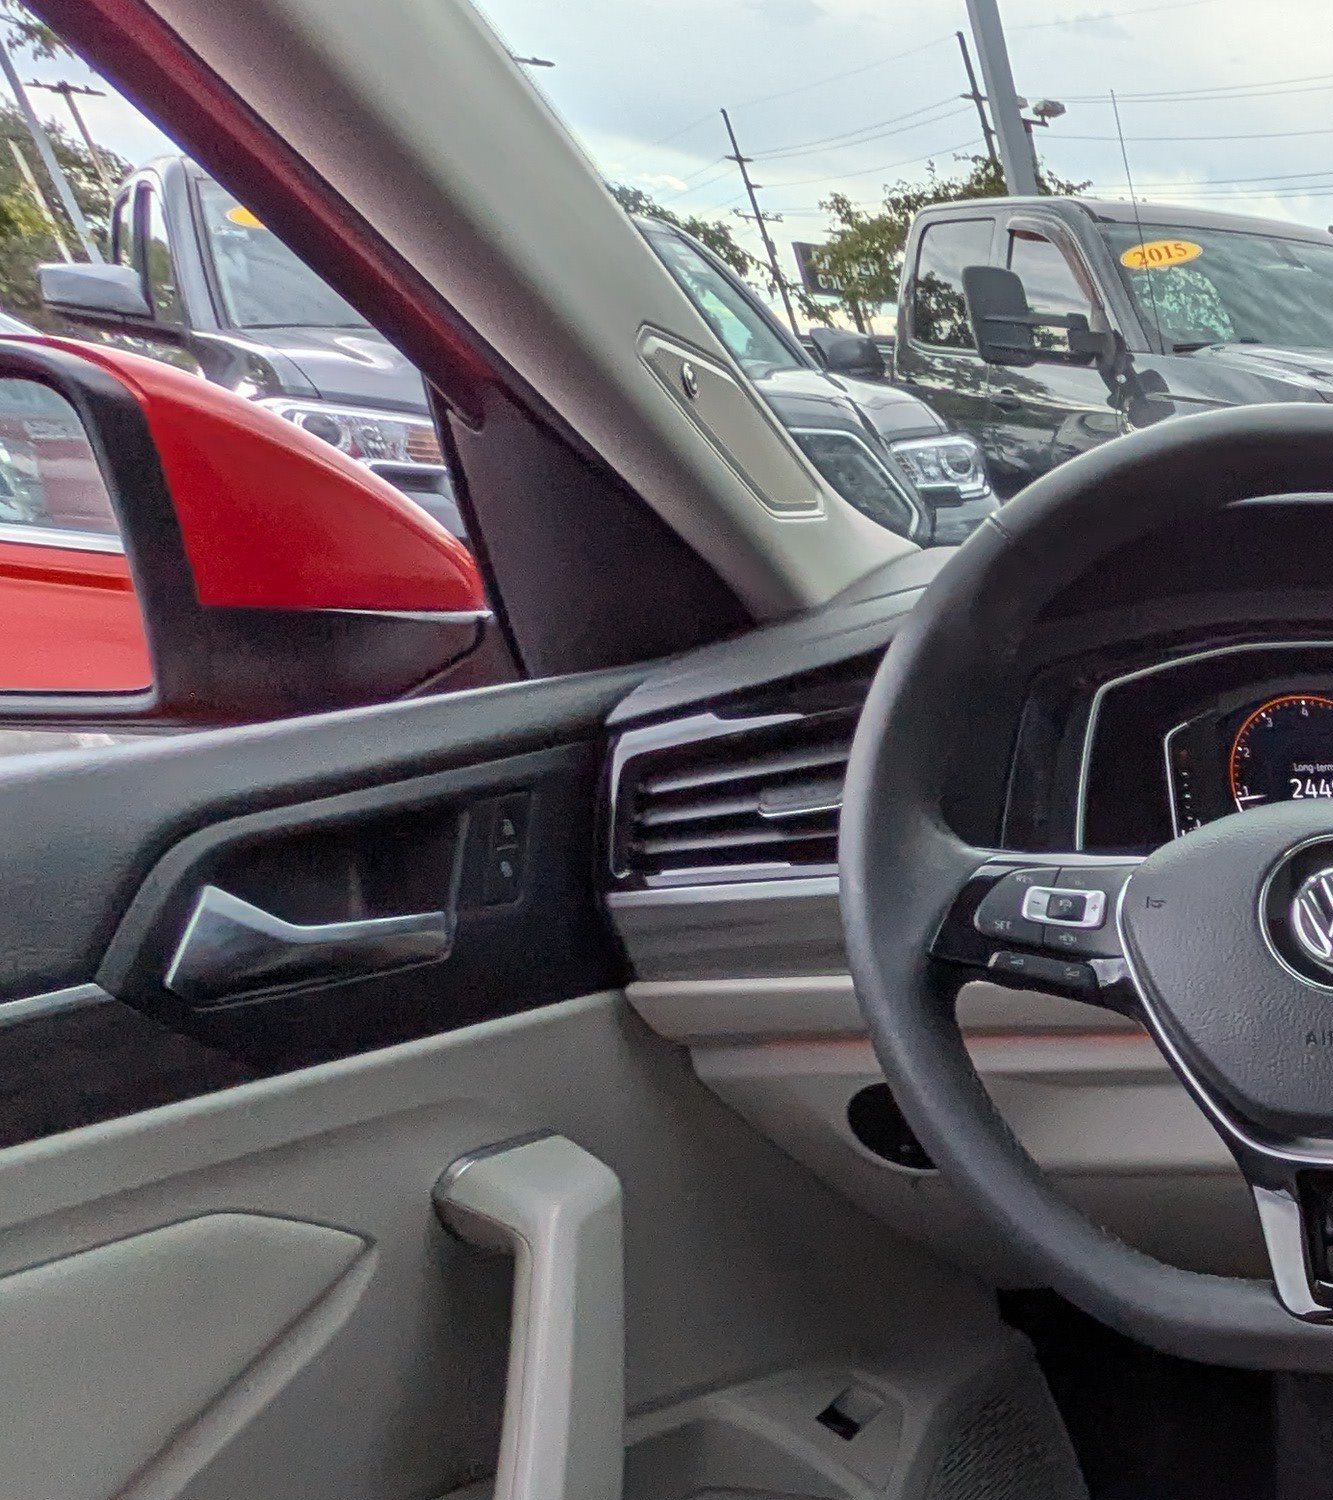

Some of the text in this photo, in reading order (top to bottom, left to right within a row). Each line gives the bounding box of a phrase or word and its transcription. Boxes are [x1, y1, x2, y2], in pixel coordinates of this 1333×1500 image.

[1133, 243, 1187, 266] 2015
[1301, 707, 1309, 717] 4
[1266, 717, 1273, 728] 3
[1243, 747, 1250, 758] 2
